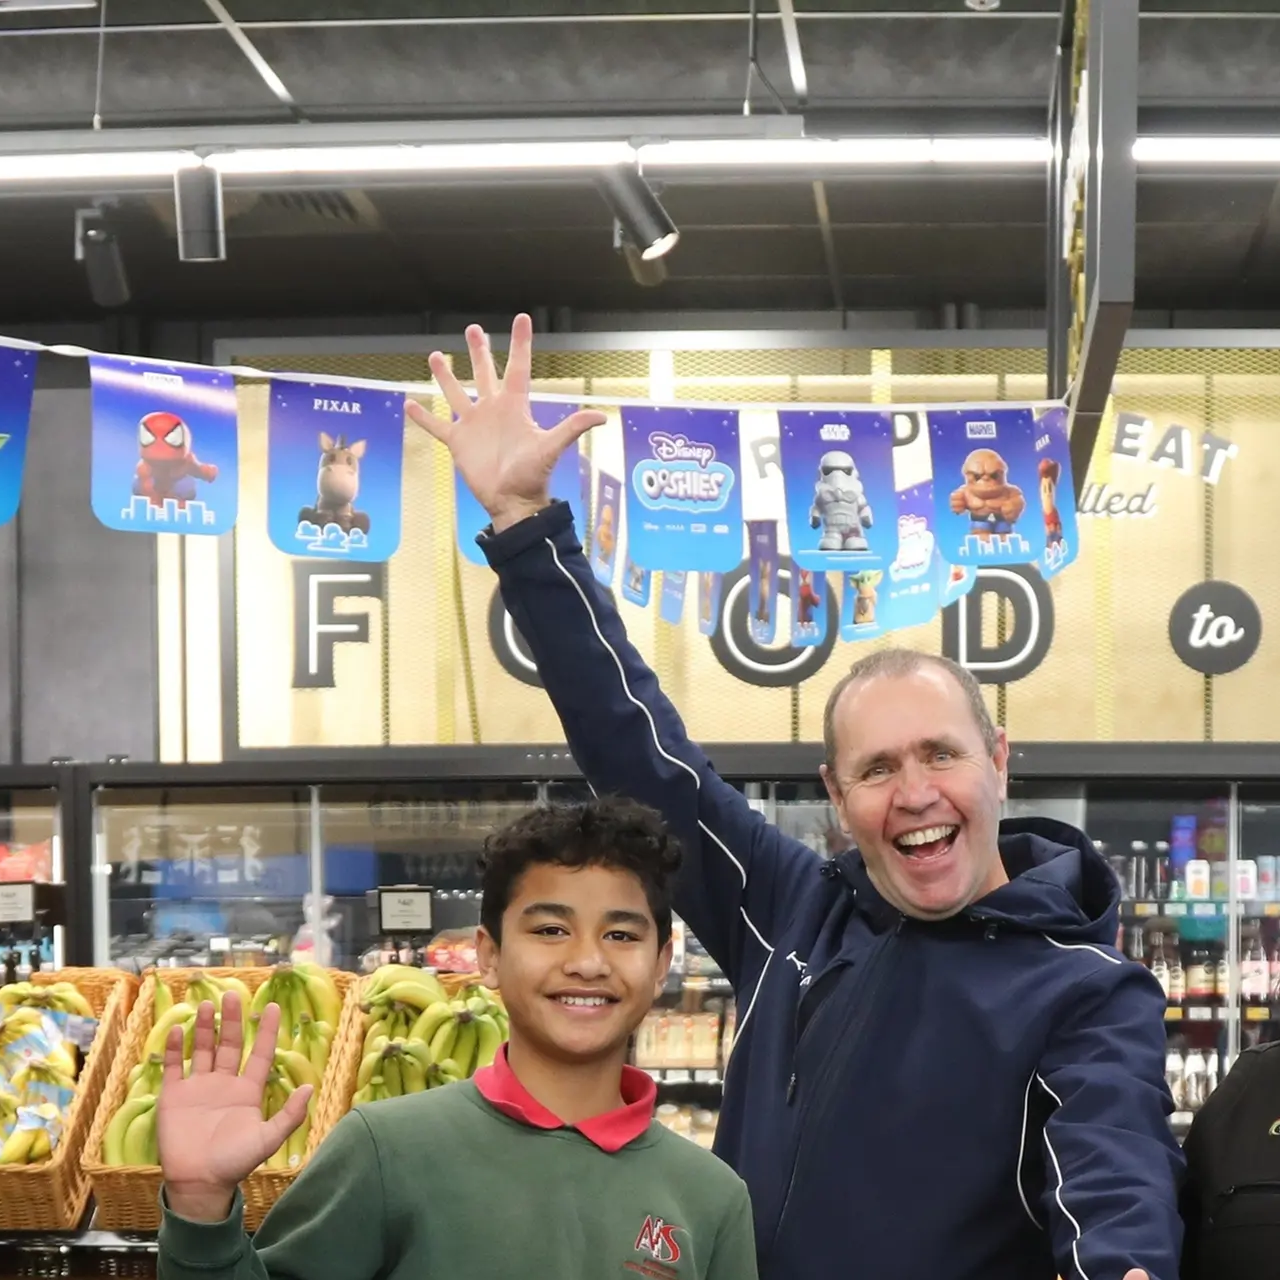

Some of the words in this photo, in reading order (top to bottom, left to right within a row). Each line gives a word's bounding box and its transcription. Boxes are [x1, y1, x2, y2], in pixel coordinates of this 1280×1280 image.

[313, 398, 362, 414] PIXAR
[968, 423, 996, 438] MARVEL
[1114, 411, 1239, 486] EAT
[1080, 482, 1154, 518] lled
[1189, 602, 1245, 648] to
